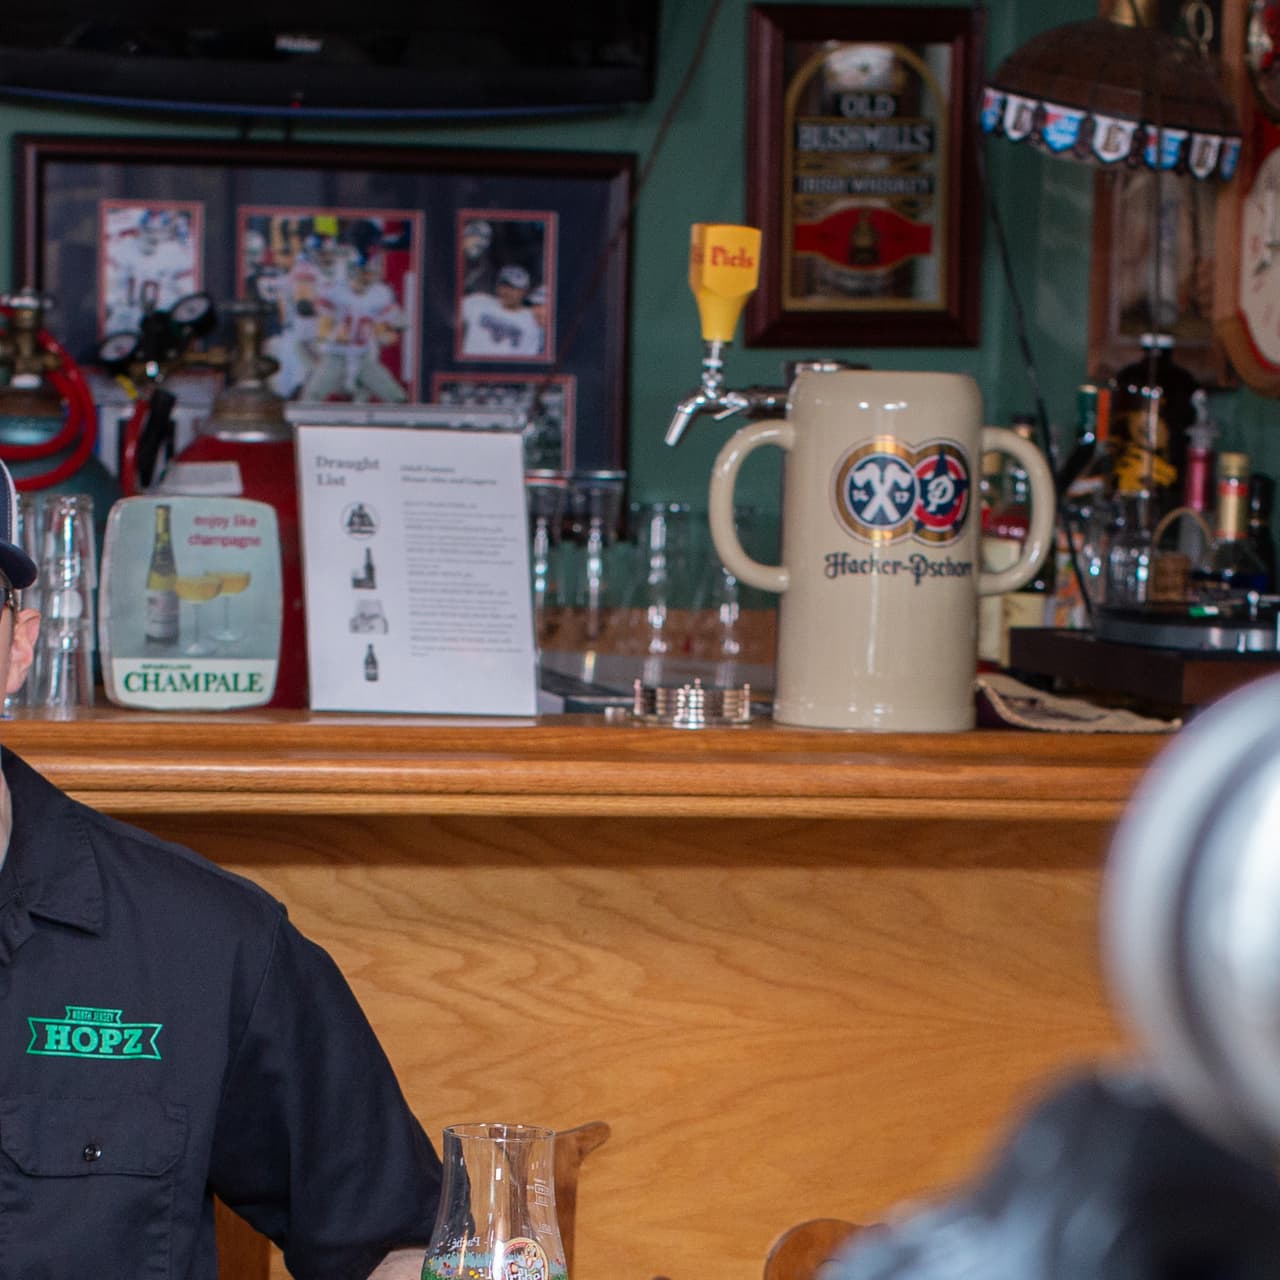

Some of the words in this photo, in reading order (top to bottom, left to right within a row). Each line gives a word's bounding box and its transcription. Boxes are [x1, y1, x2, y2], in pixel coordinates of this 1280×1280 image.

[840, 93, 897, 119] OLD
[315, 455, 381, 472] Draught
[316, 473, 347, 487] List
[194, 517, 230, 529] enjoy
[233, 514, 257, 527] like
[187, 533, 262, 549] champagne
[123, 672, 265, 694] CHAMPALE
[44, 1024, 144, 1054] HOPZ
